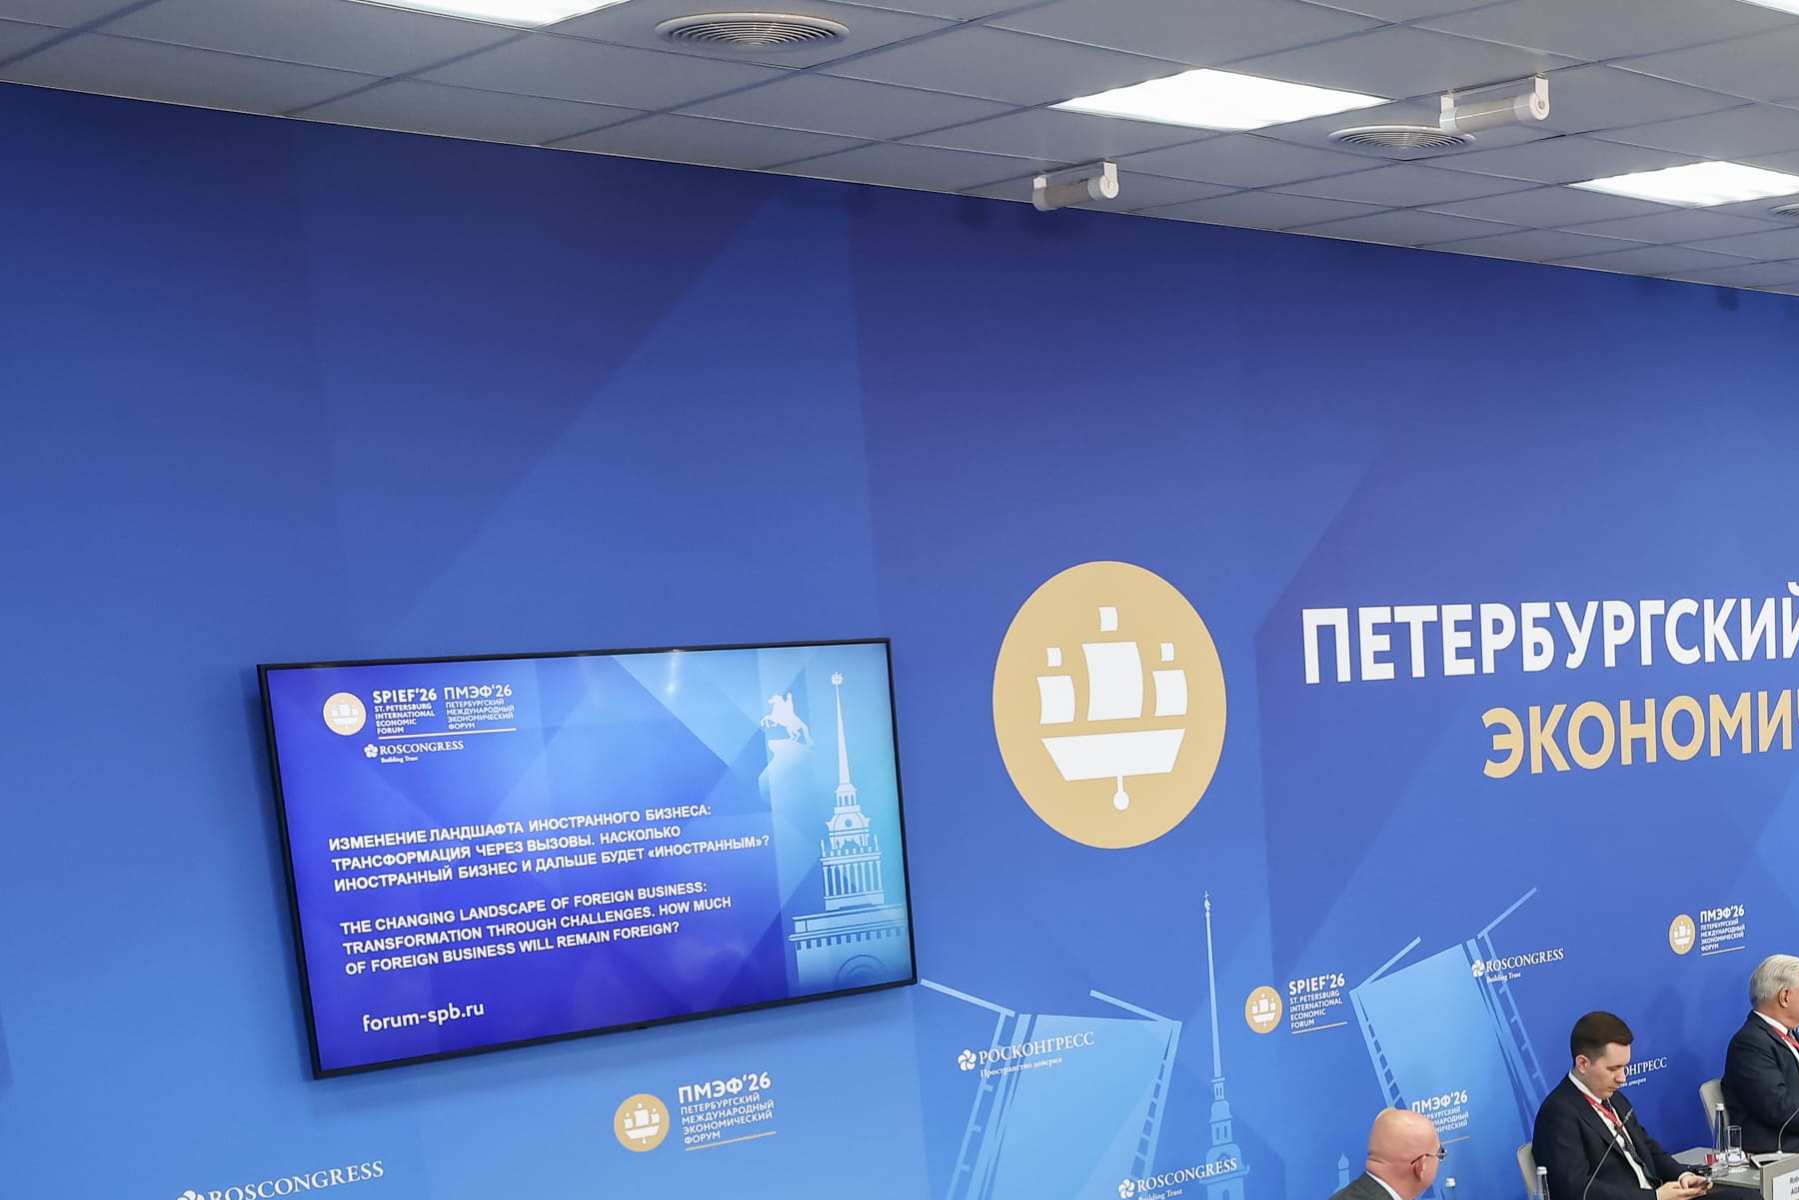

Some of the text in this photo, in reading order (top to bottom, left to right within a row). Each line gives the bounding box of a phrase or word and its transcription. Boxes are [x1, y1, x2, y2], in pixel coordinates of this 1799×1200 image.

[372, 688, 437, 704] SPIEF'26
[444, 684, 512, 700] ПМЭФ'26
[375, 711, 435, 720] INTERNATIONAL
[386, 703, 432, 712] PETERSBURG
[446, 705, 515, 715] МЕЖДУНАРОДНЫЙ
[448, 712, 514, 723] ЭКОНОМИЧЕСКИЙ
[376, 719, 416, 727] ECONOMIC
[377, 726, 404, 735] FORUM
[448, 722, 475, 730] ФОРУМ
[379, 740, 464, 755] ROSCONGRESS
[329, 804, 711, 851] ИЗМЕНЕНИЕ ЛАНДШАФТА ИНОСТРАННОГО БИЗНЕСА:
[331, 825, 680, 872] ТРАНСФОРМАЦИЯ ЧЕРЕЗ ВЫЗОВЫ. НАСКОЛЬКО
[334, 835, 770, 893] ИНОСТРАННЫЙ БИЗНЕС И ДАЛЬШЕ БУДЕТ «ИНОСТРАННЫМ»?
[340, 881, 707, 935] THE CHANGING LANDSCAPE OF FOREIGN BUSINESS:
[1700, 904, 1744, 923] ПМЭФ'26
[343, 896, 731, 955] TRANSFORMATION THROUGH CHALLENGES. HOW MUCH
[345, 921, 679, 975] OF FOREIGN BUSINESS WILL REMAIN FOREIGN?
[1486, 948, 1564, 973] ROSCONGRESS
[1289, 973, 1345, 995] SPIEF'26
[362, 1002, 484, 1032] forum-spb.ru
[979, 1032, 1095, 1064] РОСКОНГРЕСС
[678, 1071, 772, 1103] ПМЭФ'26
[680, 1092, 760, 1115] ПЕТЕРБУРГСКИЙ
[681, 1100, 774, 1125] МЕЖДУНАРОДНЫЙ
[1412, 1090, 1468, 1113] ПМЭФ'26
[683, 1111, 773, 1135] ЭКОНОМИЧЕСКИЙ
[684, 1131, 721, 1145] ФОРУМ
[1137, 1158, 1237, 1192] ROSCONGRESS
